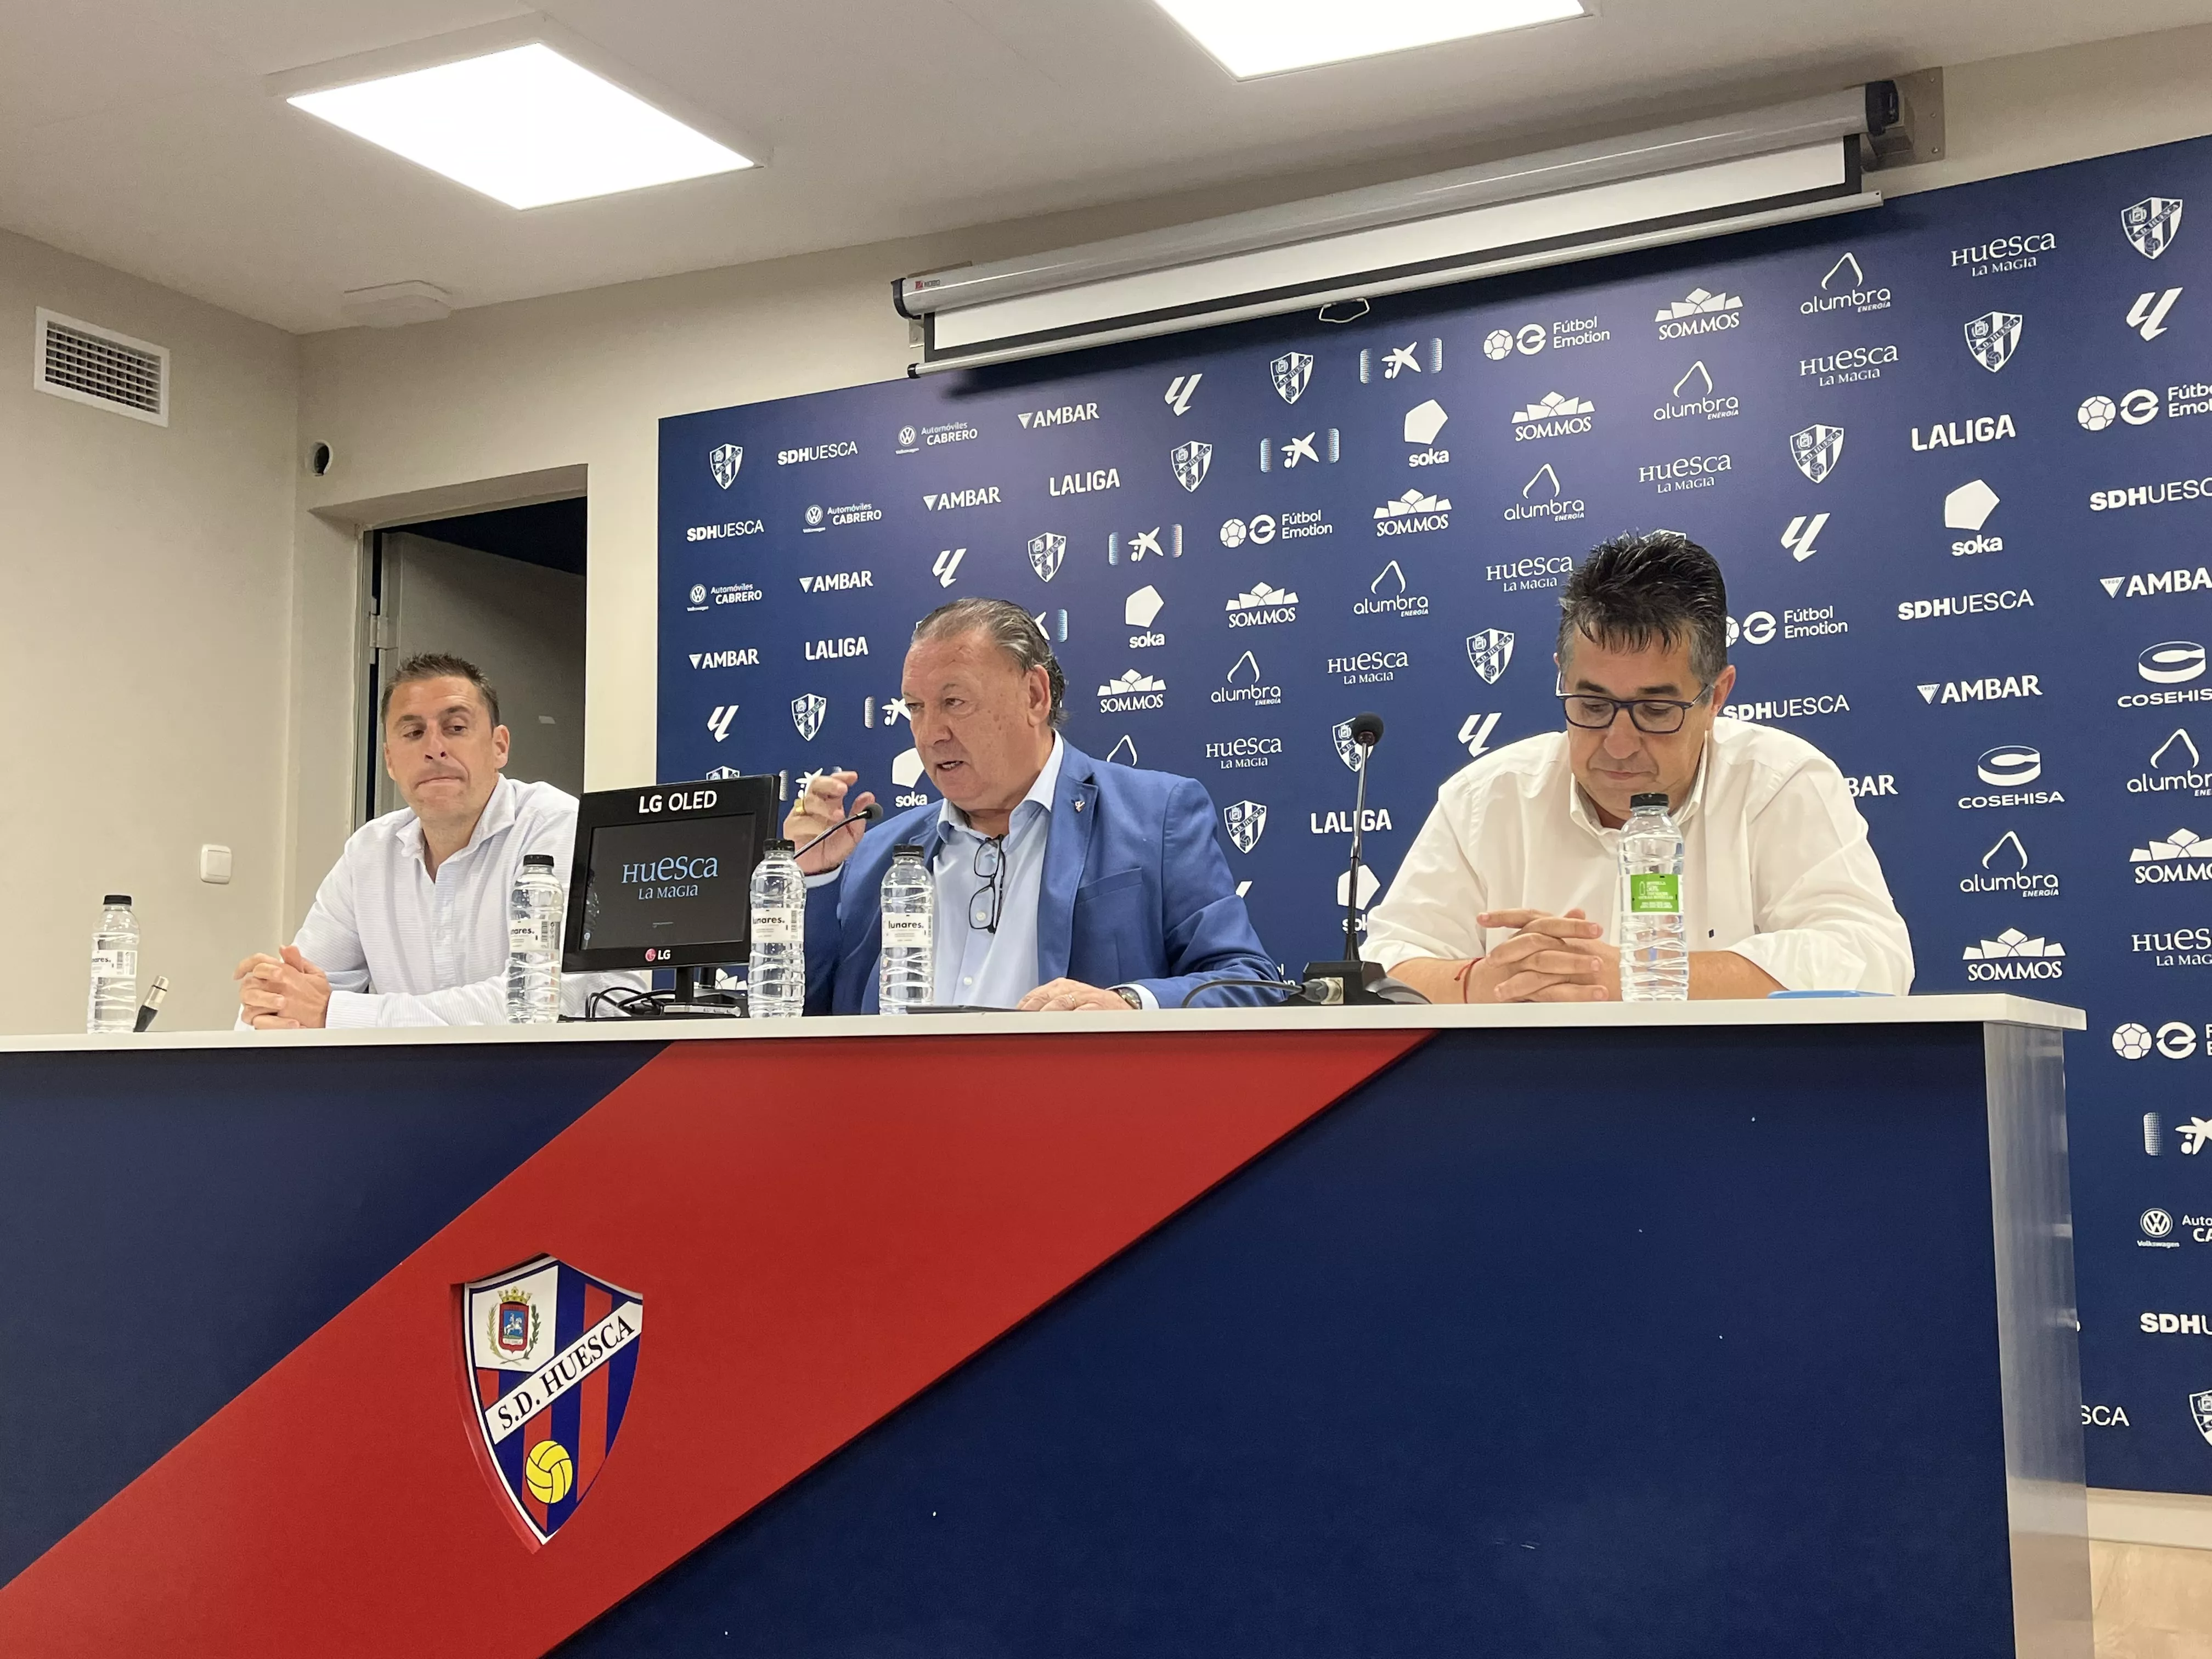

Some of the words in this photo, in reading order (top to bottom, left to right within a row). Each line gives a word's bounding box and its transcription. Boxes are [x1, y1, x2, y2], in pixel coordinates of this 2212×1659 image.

[1801, 289, 1890, 314] alumbra
[1554, 316, 1597, 334] Fútbol
[1659, 313, 1739, 340] SOMMOS
[1554, 331, 1610, 348] Emotion
[2168, 383, 2212, 401] Fútb
[1033, 403, 1099, 428] AMBAR
[1654, 397, 1739, 420] alumbra
[922, 422, 967, 435] Automóviles
[927, 428, 978, 445] CABRERO
[1515, 416, 1591, 441] SOMMOS
[1912, 415, 2016, 451] LALIGA
[778, 441, 857, 465] SDHUESCA
[1409, 448, 1449, 467] soka
[1050, 469, 1120, 496] LALIGA
[938, 487, 1001, 510] AMBAR
[827, 503, 872, 515] Automóviles
[833, 510, 882, 525] CABRERO
[1282, 510, 1321, 525] Fútbol
[1504, 499, 1584, 521] alumbra
[687, 520, 764, 541] SDHUESCA
[1283, 523, 1332, 539] Emotion
[1377, 514, 1448, 536] SOMMOS
[1952, 535, 2002, 556] soka
[711, 583, 753, 594] Automóviles
[813, 571, 873, 592] AMBAR
[716, 590, 762, 604] CABRERO
[1354, 595, 1428, 614] alumbra
[1898, 589, 2034, 620] SDHUESCA
[1229, 607, 1295, 628] SOMMOS
[1785, 606, 1833, 623] Fútbol
[1785, 621, 1847, 638] Emotion
[806, 637, 868, 660] LALIGA
[1130, 631, 1164, 648] soka
[702, 649, 759, 669] AMBAR
[1211, 685, 1280, 703] alumbra
[1941, 675, 2042, 703] AMBAR
[1101, 694, 1163, 713] SOMMOS
[1723, 695, 1850, 721] SDHUESCA
[639, 795, 662, 813] LG
[669, 791, 716, 810] OLED
[895, 791, 927, 807] soka
[1959, 792, 2064, 808] COSEHISA
[1960, 872, 2058, 893] alumbra
[888, 921, 924, 929] lunares.
[658, 950, 670, 960] LG
[1968, 961, 2062, 980] SOMMOS
[498, 1392, 540, 1430] S.D.
[540, 1316, 635, 1397] HUESCA
